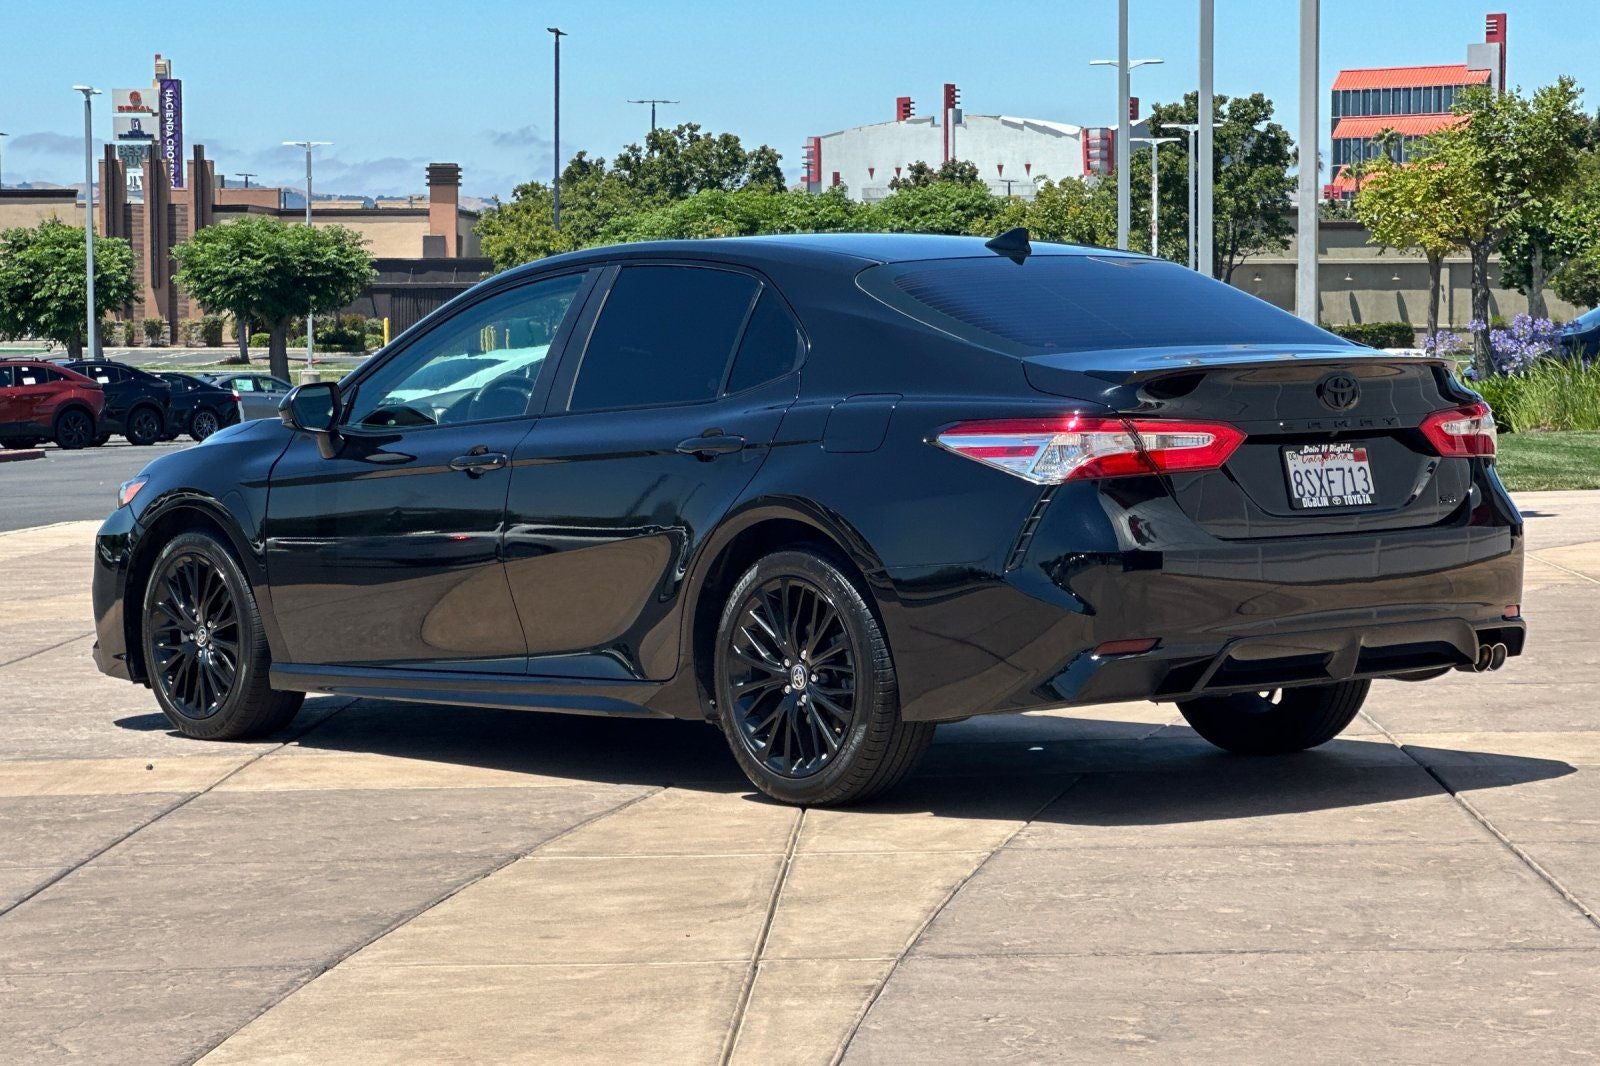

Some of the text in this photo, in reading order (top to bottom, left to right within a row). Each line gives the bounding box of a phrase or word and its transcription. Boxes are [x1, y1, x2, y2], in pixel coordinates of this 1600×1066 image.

[165, 89, 174, 138] HACIENDA
[1293, 465, 1371, 497] 8SXF713
[1343, 493, 1371, 506] TOYOTA
